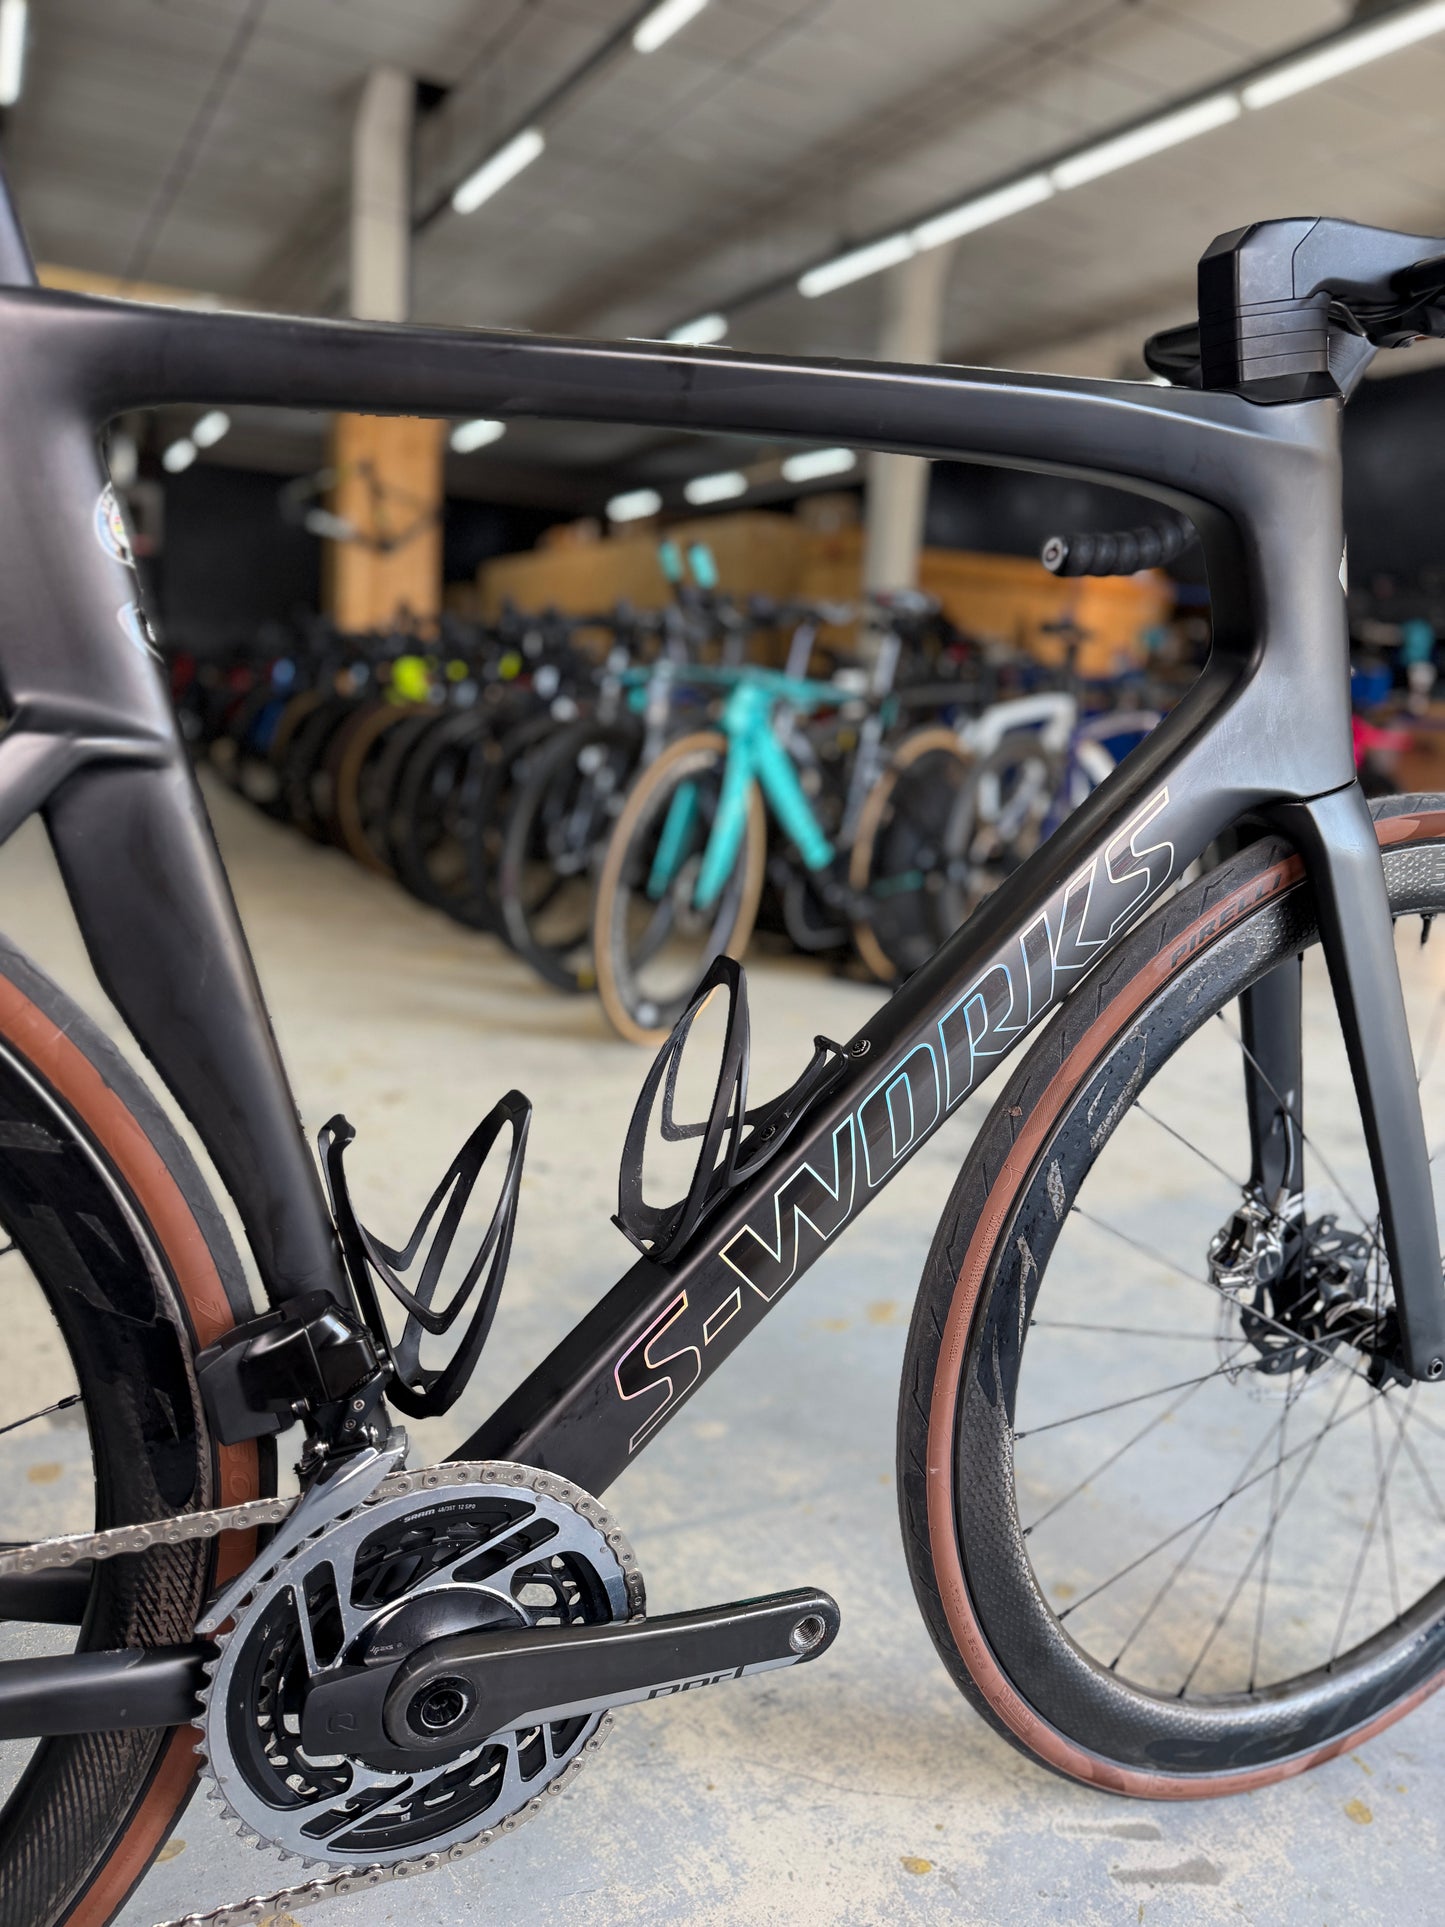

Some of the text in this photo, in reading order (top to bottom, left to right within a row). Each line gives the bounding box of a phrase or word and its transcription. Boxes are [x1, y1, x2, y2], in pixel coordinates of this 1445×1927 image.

[1170, 872, 1282, 969] PIRELLI
[615, 786, 1175, 1454] S-WORKS
[403, 1508, 436, 1523] SRAM
